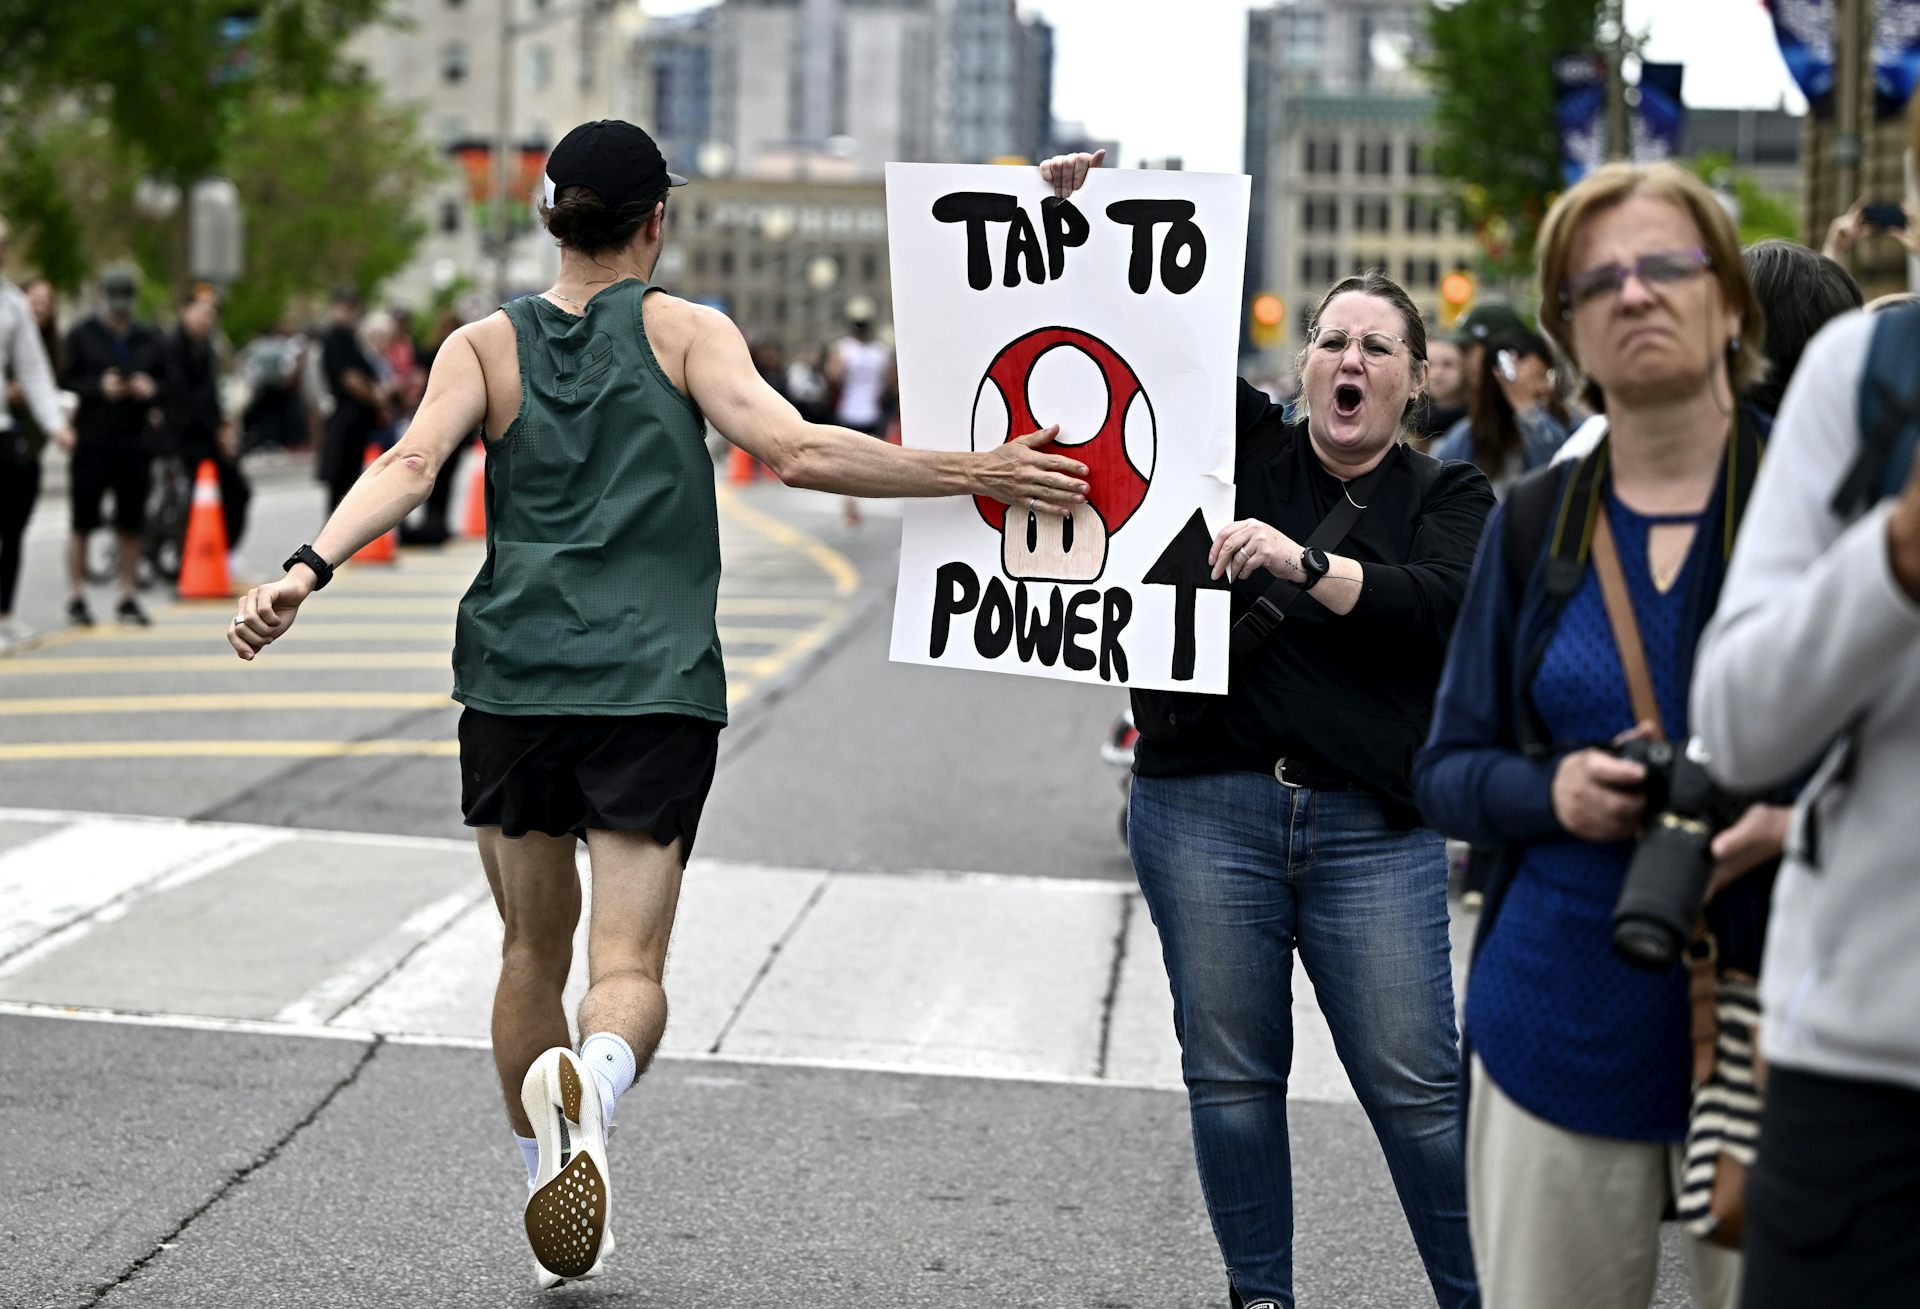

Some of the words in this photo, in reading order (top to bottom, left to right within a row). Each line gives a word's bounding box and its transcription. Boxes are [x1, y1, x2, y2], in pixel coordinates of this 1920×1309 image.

[932, 191, 1090, 291] TAP
[1105, 199, 1207, 295] TO
[929, 561, 1133, 683] POWER
